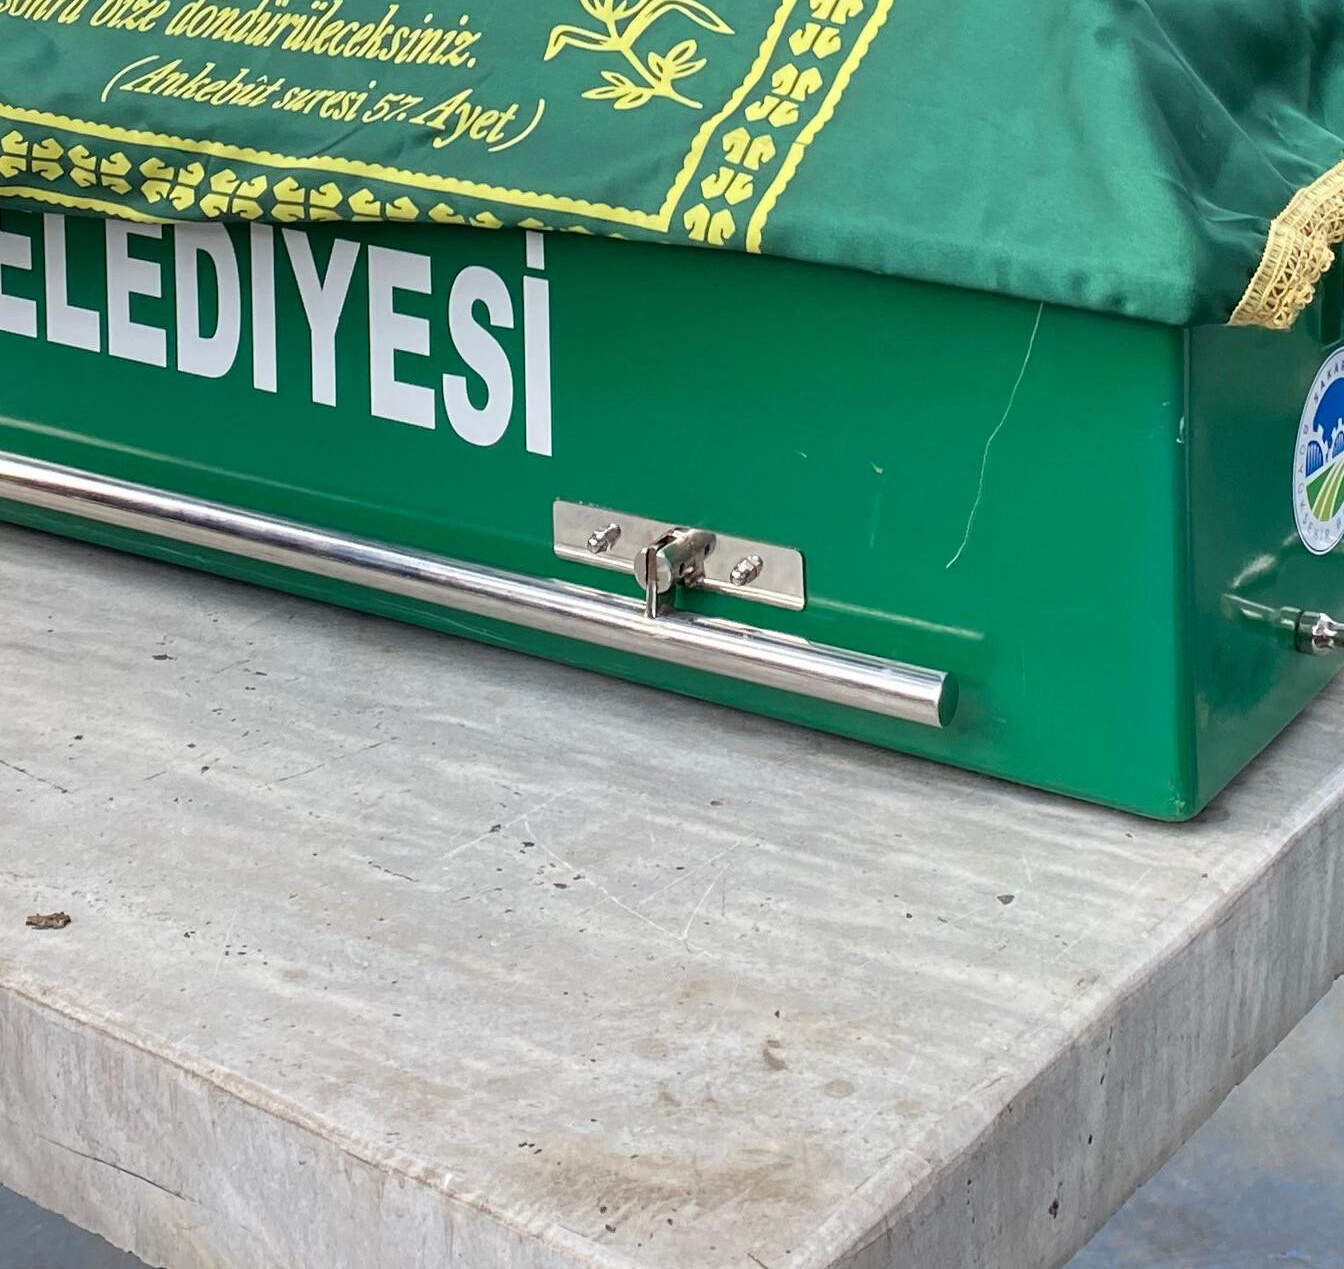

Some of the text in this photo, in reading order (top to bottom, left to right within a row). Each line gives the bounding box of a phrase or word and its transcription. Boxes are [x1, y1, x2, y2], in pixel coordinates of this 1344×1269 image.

[100, 53, 282, 109] (Ankebût
[277, 78, 377, 126] suresi
[362, 92, 413, 123] 57.
